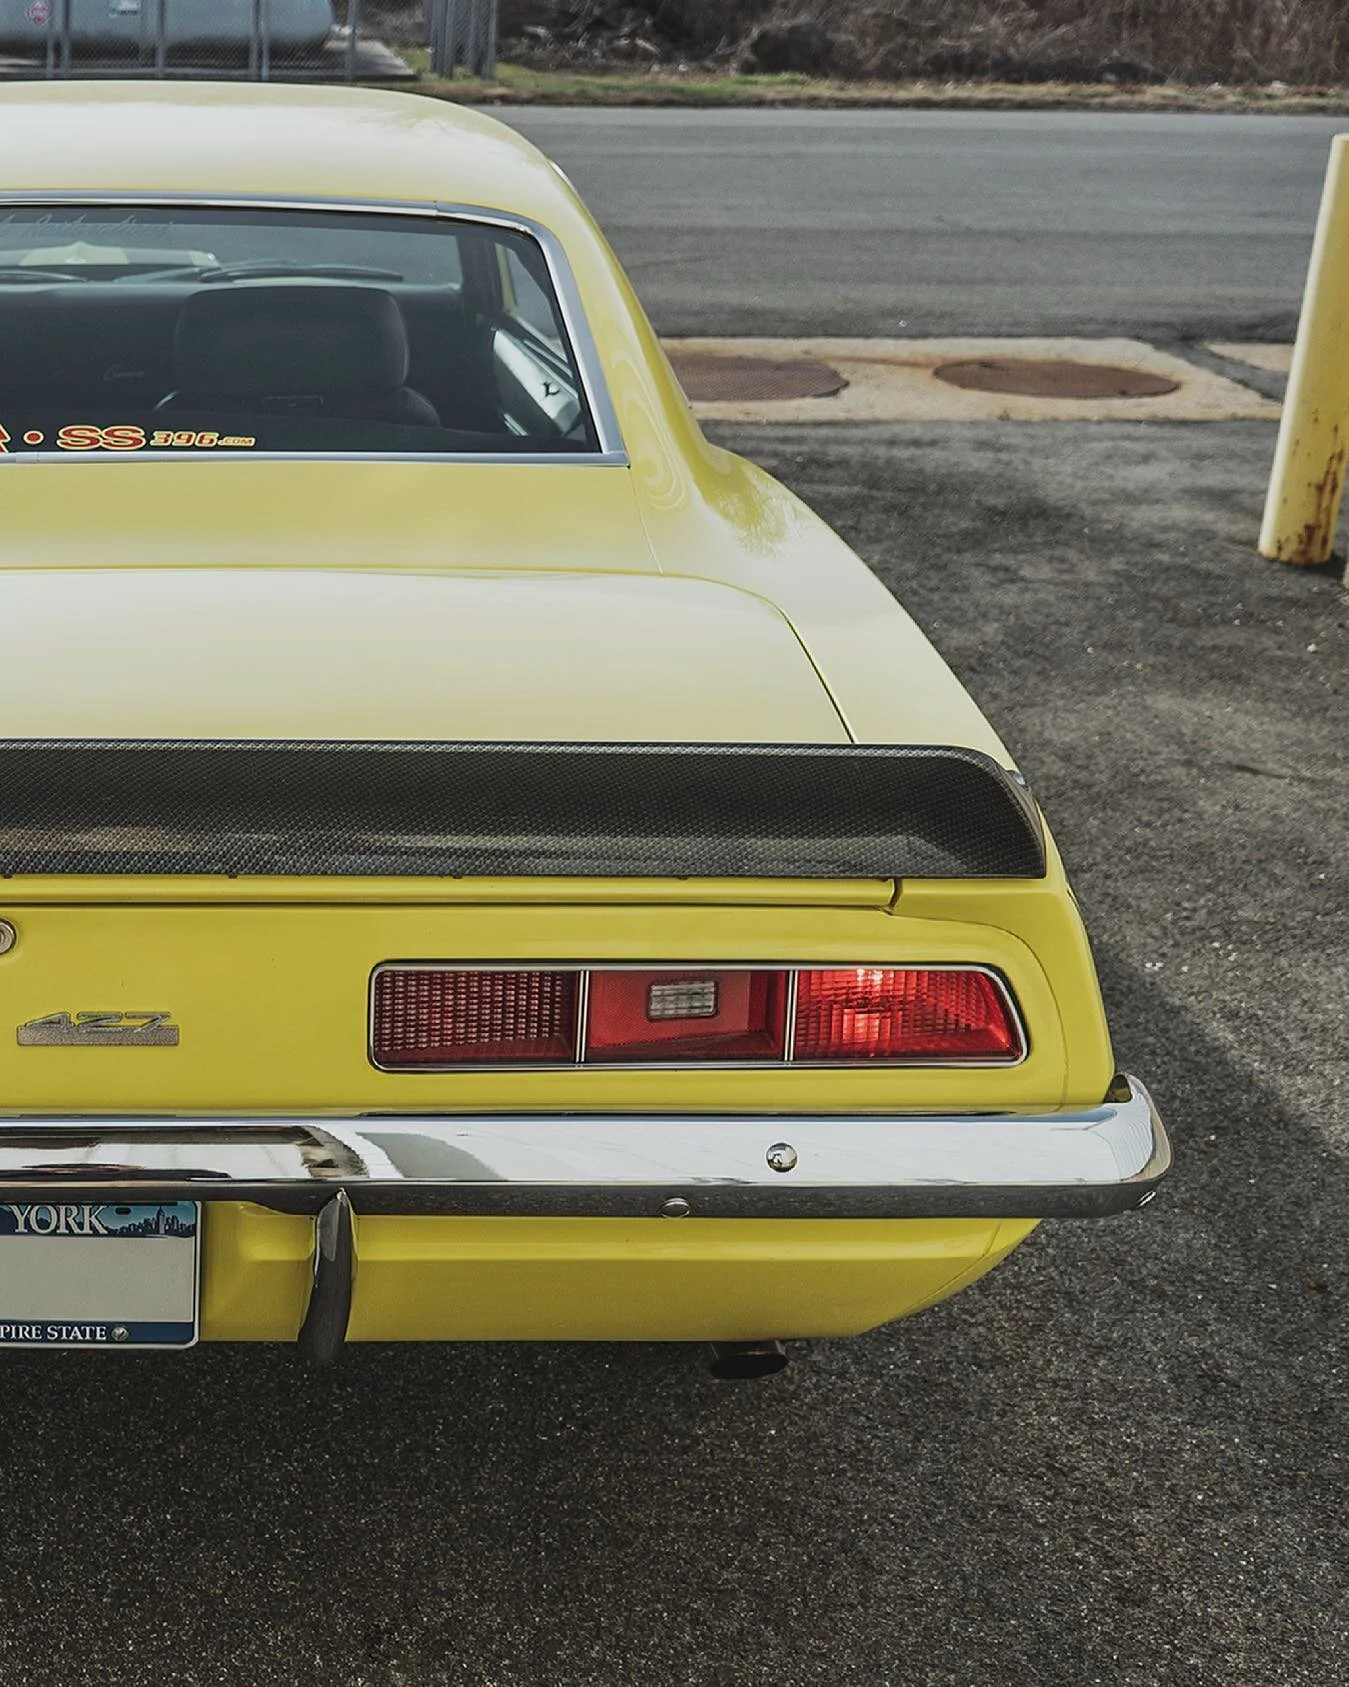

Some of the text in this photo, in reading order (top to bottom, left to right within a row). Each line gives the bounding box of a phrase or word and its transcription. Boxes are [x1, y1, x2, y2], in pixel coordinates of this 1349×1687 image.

[24, 1011, 172, 1035] 427
[8, 1204, 109, 1235] YORK
[47, 1325, 107, 1341] STATE
